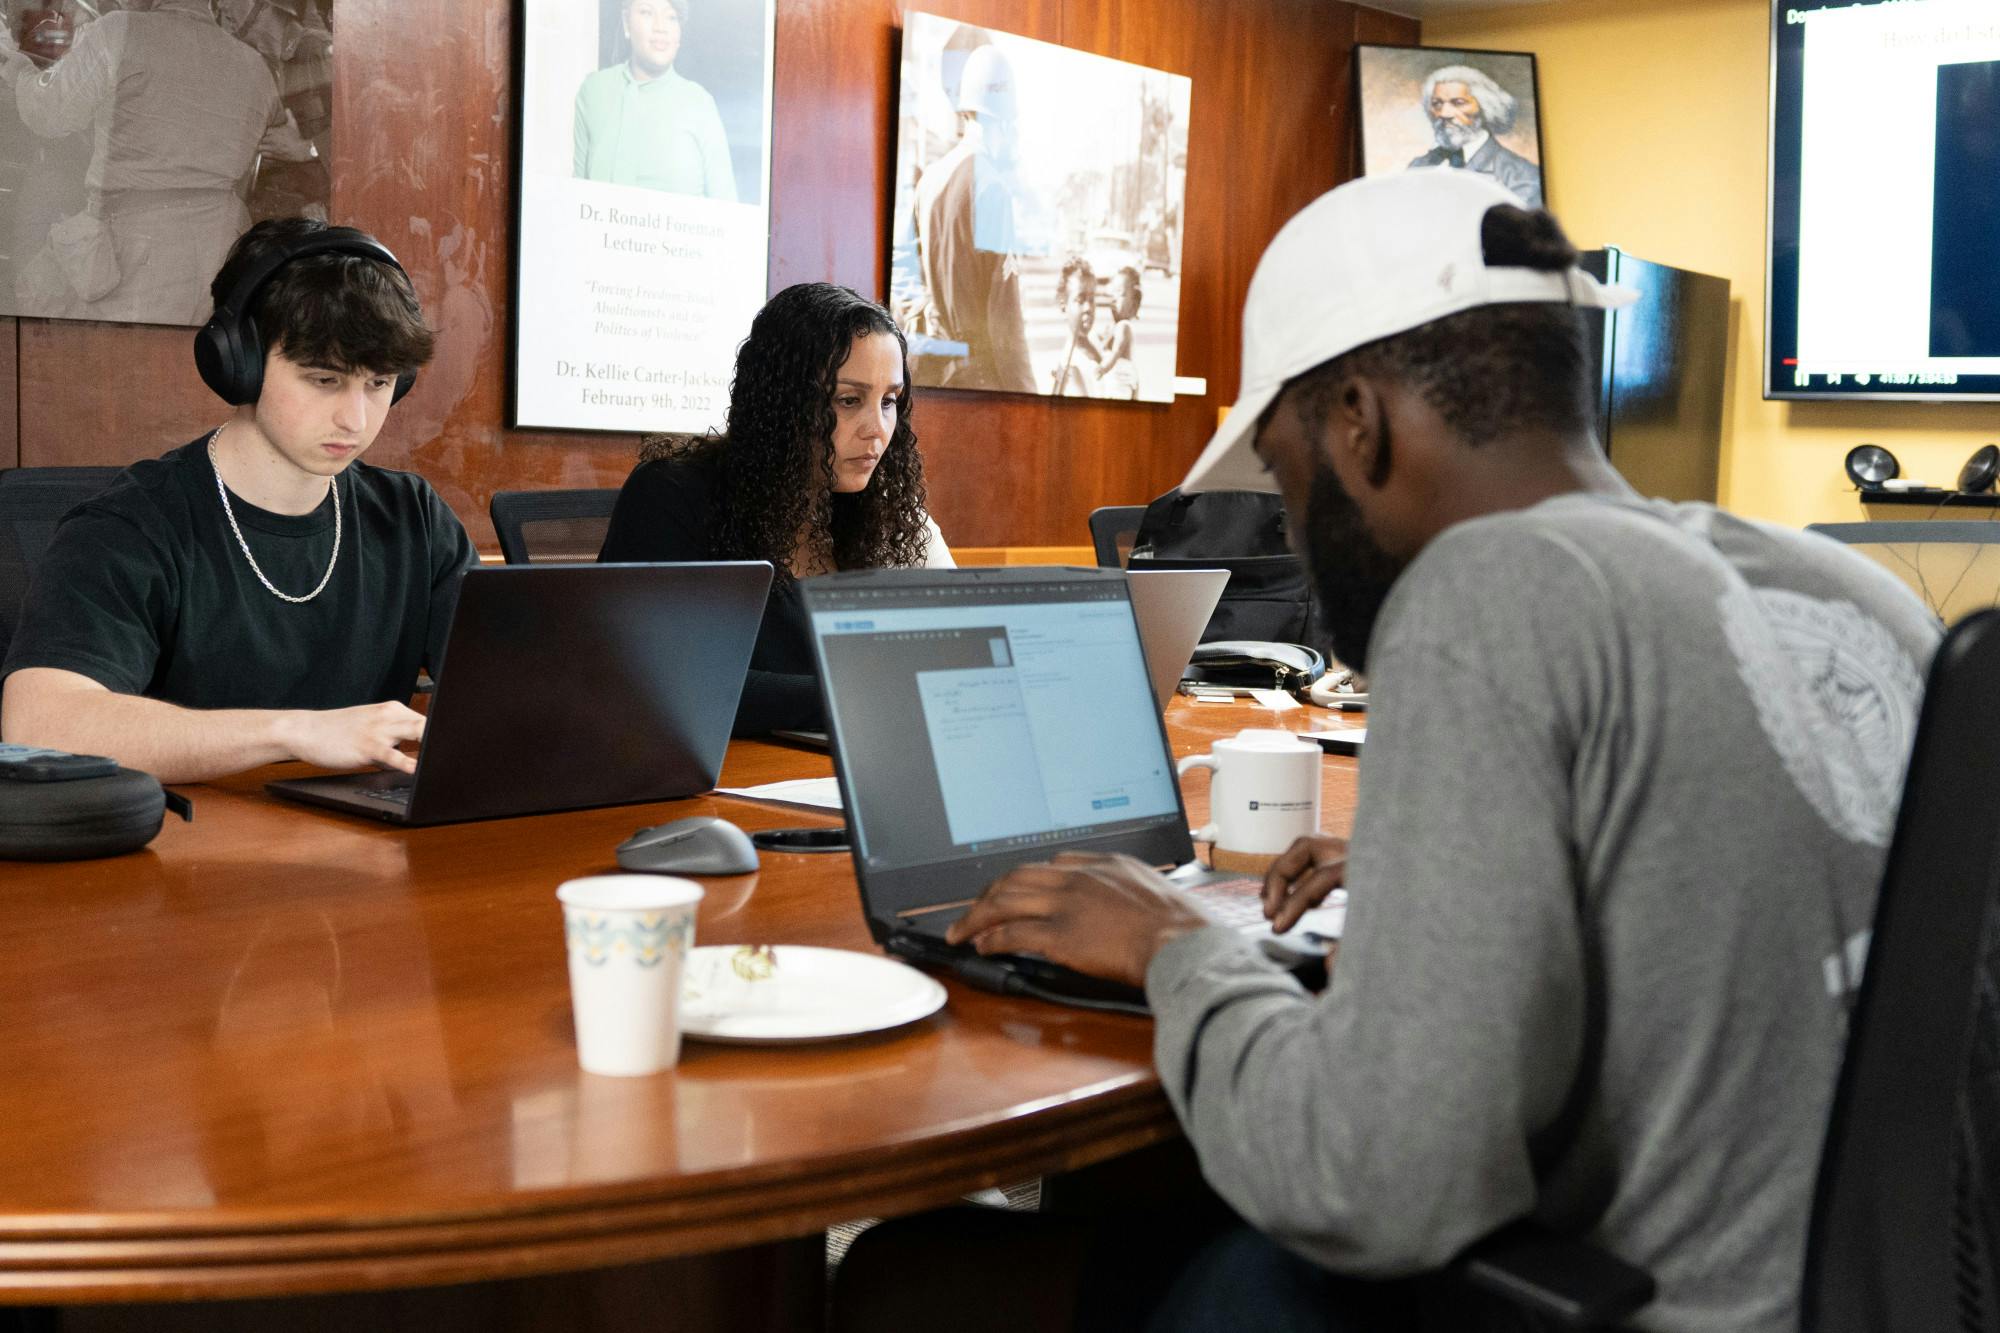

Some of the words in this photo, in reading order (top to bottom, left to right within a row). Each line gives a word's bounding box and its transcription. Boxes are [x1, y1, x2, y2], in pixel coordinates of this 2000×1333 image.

[580, 203, 603, 222] Dr.
[609, 207, 661, 229] Ronald
[666, 215, 725, 238] Foreman
[604, 233, 656, 254] Lecture
[662, 241, 703, 258] Series
[594, 321, 638, 336] Politics
[640, 327, 653, 342] of
[556, 360, 580, 377] Dr.
[585, 362, 629, 381] Kellie
[582, 388, 646, 412] February
[651, 392, 677, 410] 9th,
[681, 395, 711, 410] 2022
